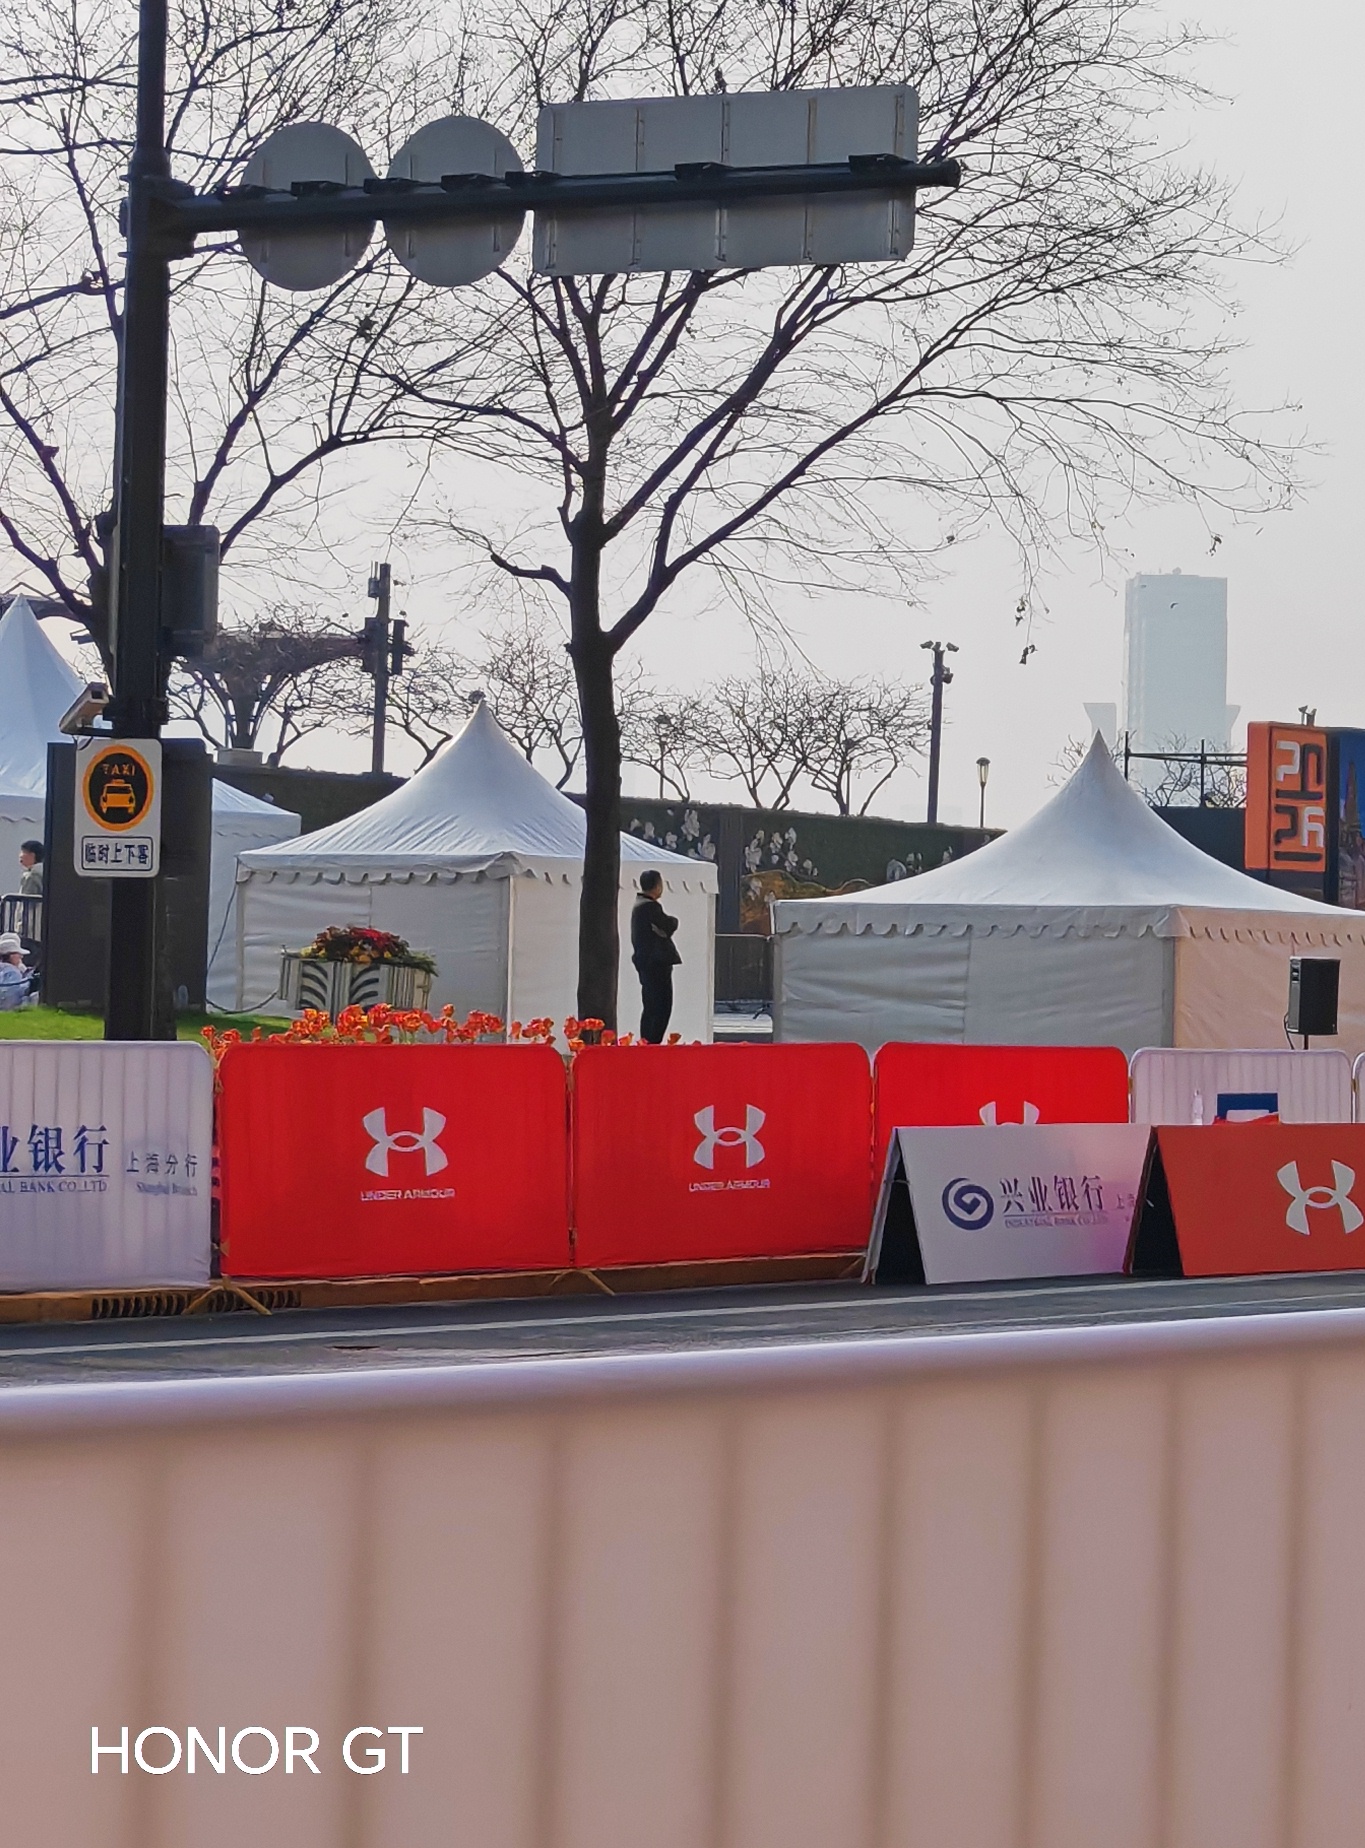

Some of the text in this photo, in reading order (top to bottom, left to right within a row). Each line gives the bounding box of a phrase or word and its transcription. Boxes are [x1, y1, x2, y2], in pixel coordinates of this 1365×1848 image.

[101, 763, 136, 777] TAXI
[85, 843, 149, 865] 临时上下客
[126, 1151, 198, 1178] 上海分行
[361, 1190, 402, 1201] UNDER
[1000, 1175, 1103, 1213] 兴业银行
